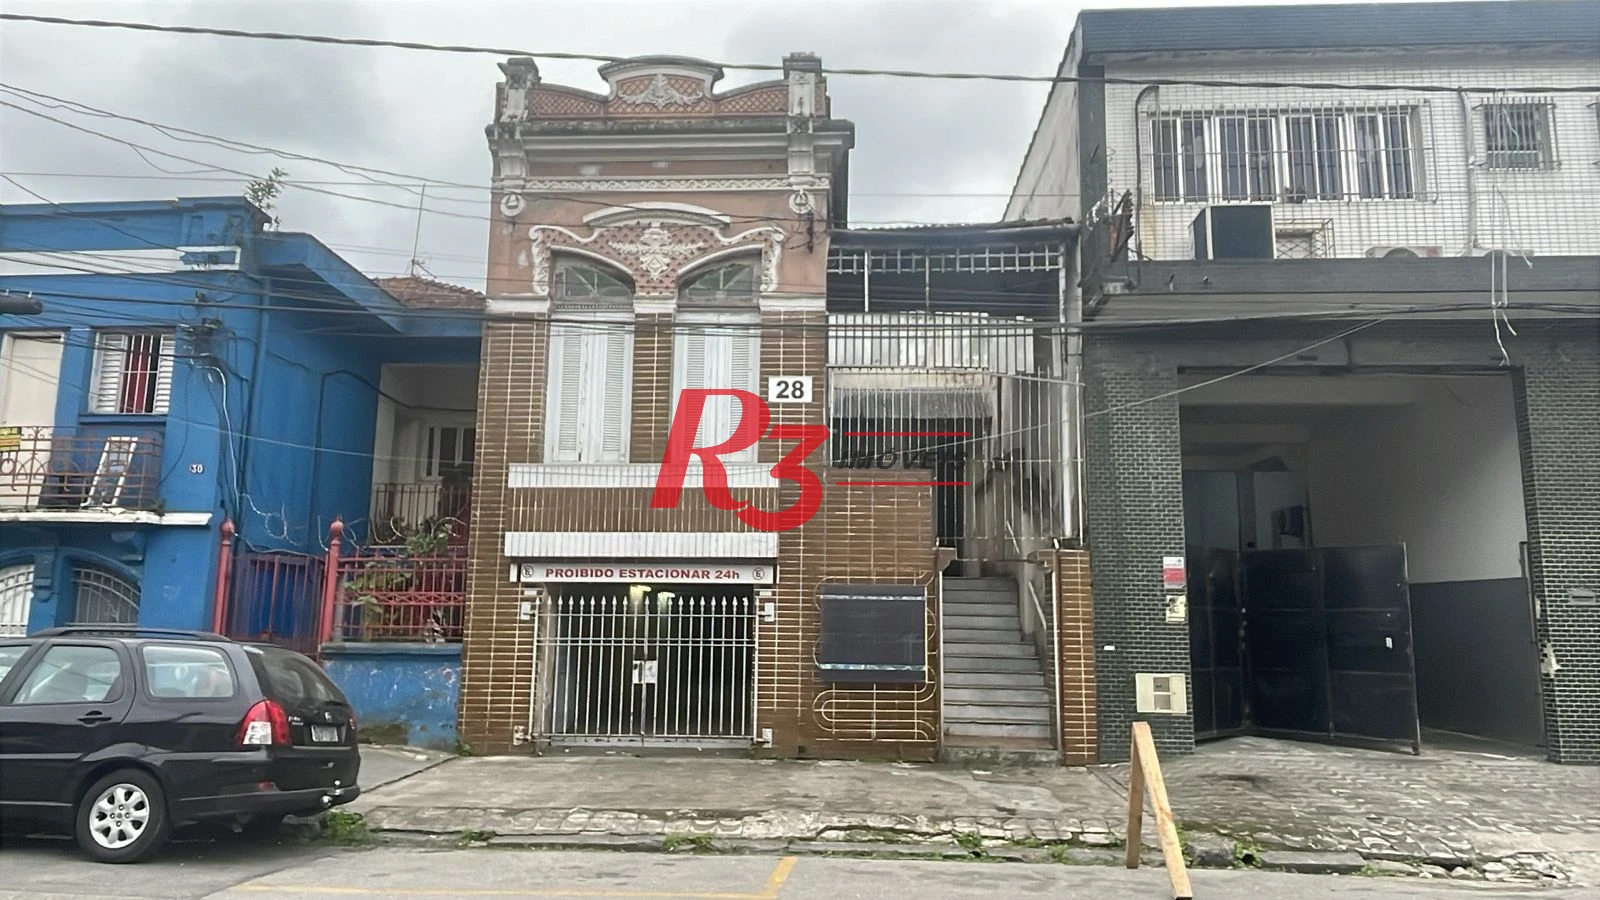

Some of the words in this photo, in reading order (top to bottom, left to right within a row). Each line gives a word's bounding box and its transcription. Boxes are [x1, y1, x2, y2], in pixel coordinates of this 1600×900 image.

[775, 380, 805, 399] 28
[191, 464, 203, 474] 30
[545, 568, 614, 578] PROIBIDO
[619, 568, 710, 579] ESTACIONAR
[715, 569, 740, 580] 24h
